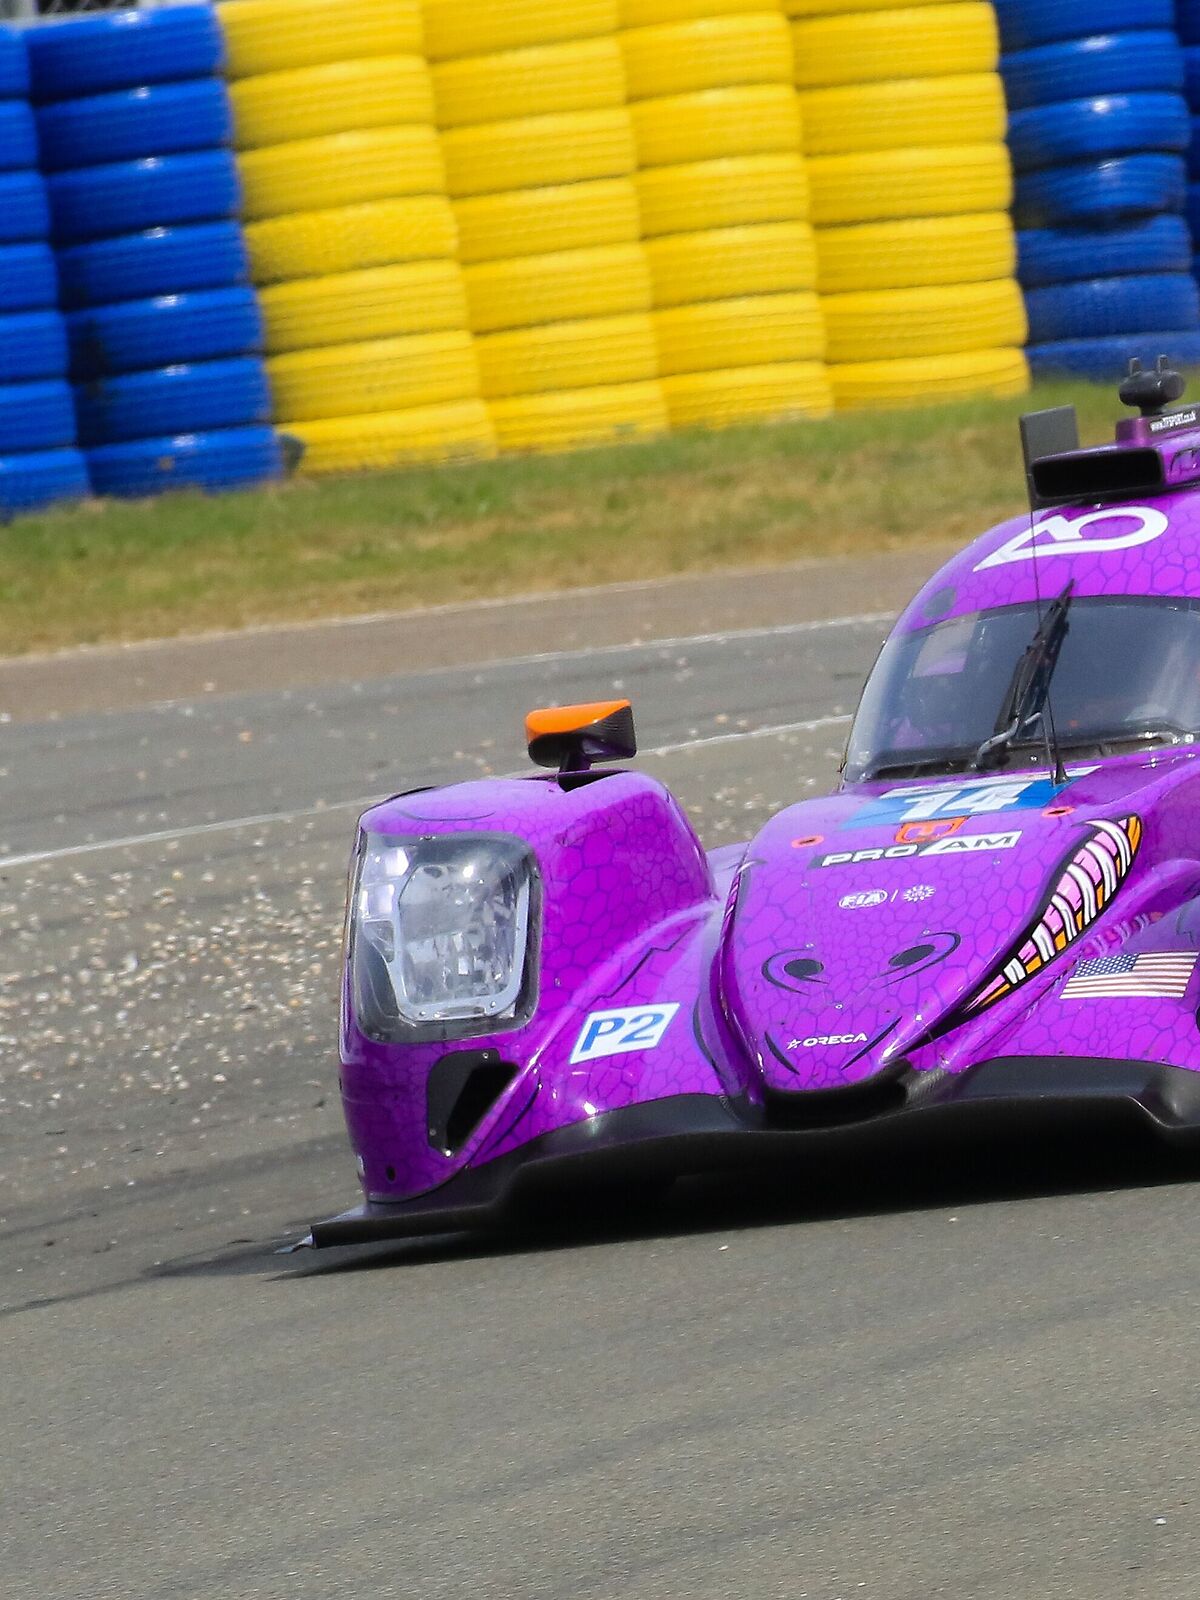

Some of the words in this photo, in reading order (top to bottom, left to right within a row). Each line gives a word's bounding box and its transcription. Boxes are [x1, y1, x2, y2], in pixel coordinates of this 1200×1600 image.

[899, 782, 1034, 822] 14
[578, 1012, 666, 1053] P2
[803, 1033, 868, 1047] ORECA
